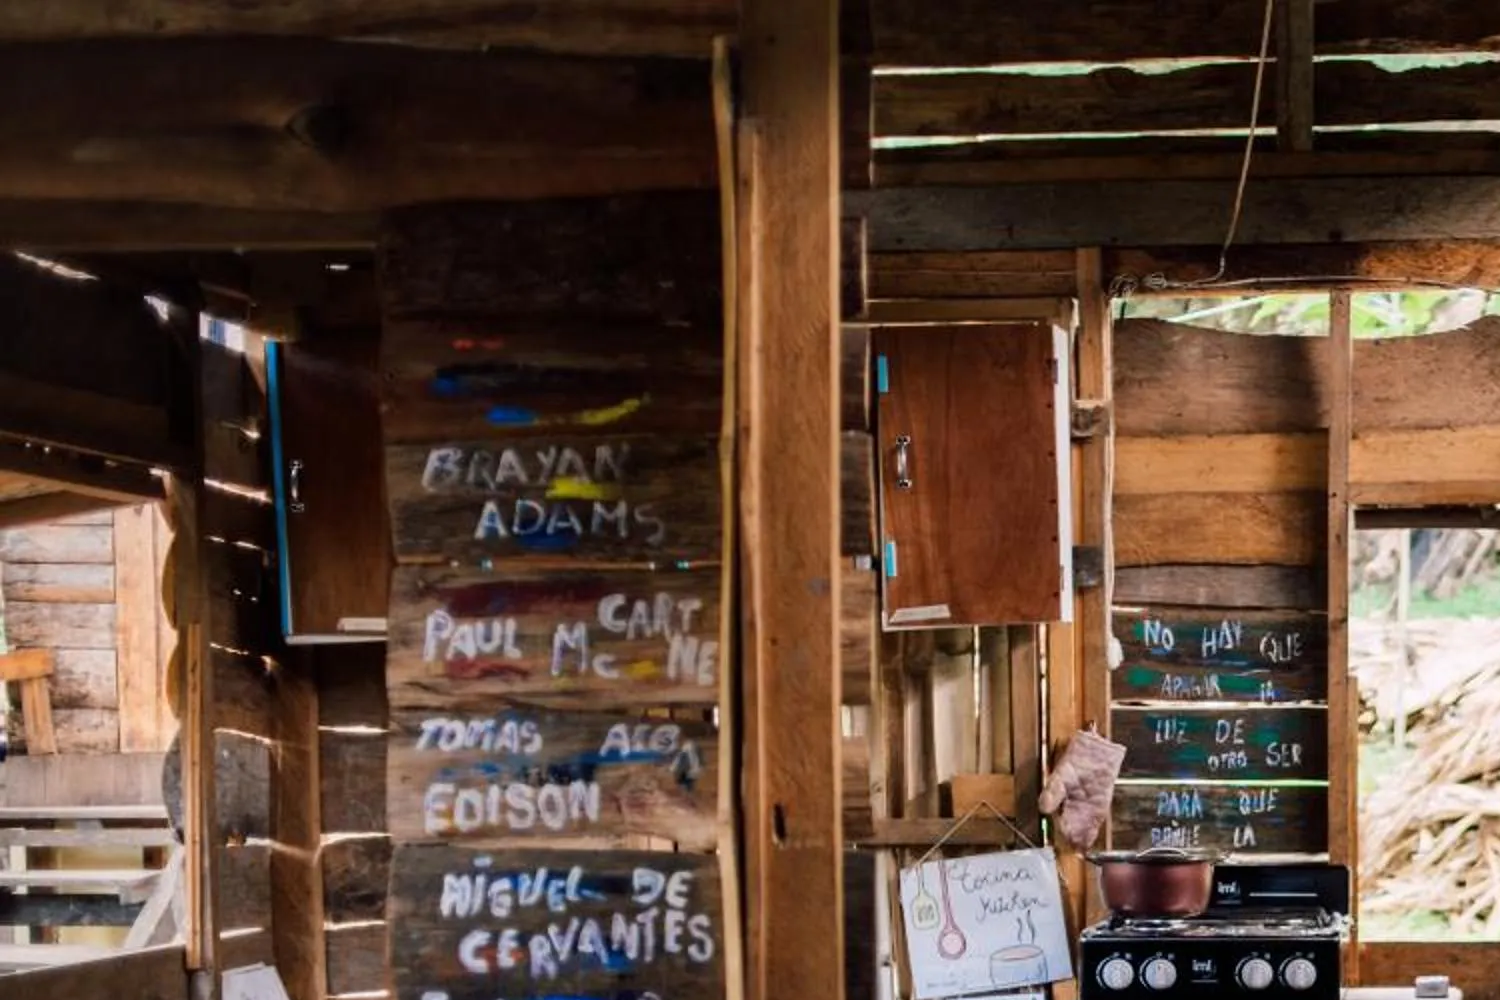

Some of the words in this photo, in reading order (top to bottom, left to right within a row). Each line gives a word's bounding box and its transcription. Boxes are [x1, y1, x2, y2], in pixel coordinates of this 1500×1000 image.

[474, 499, 665, 543] ADAMS
[424, 609, 522, 662] PAUL
[1144, 619, 1175, 650] NO
[1202, 619, 1243, 657] HAY
[1259, 632, 1303, 663] QUE
[416, 717, 543, 755] TOMAS
[1215, 719, 1246, 745] DE
[1265, 742, 1303, 767] SER
[424, 781, 600, 834] EDISON
[1233, 824, 1257, 849] LA
[632, 867, 693, 908] DE
[457, 909, 714, 979] CERVANTES
